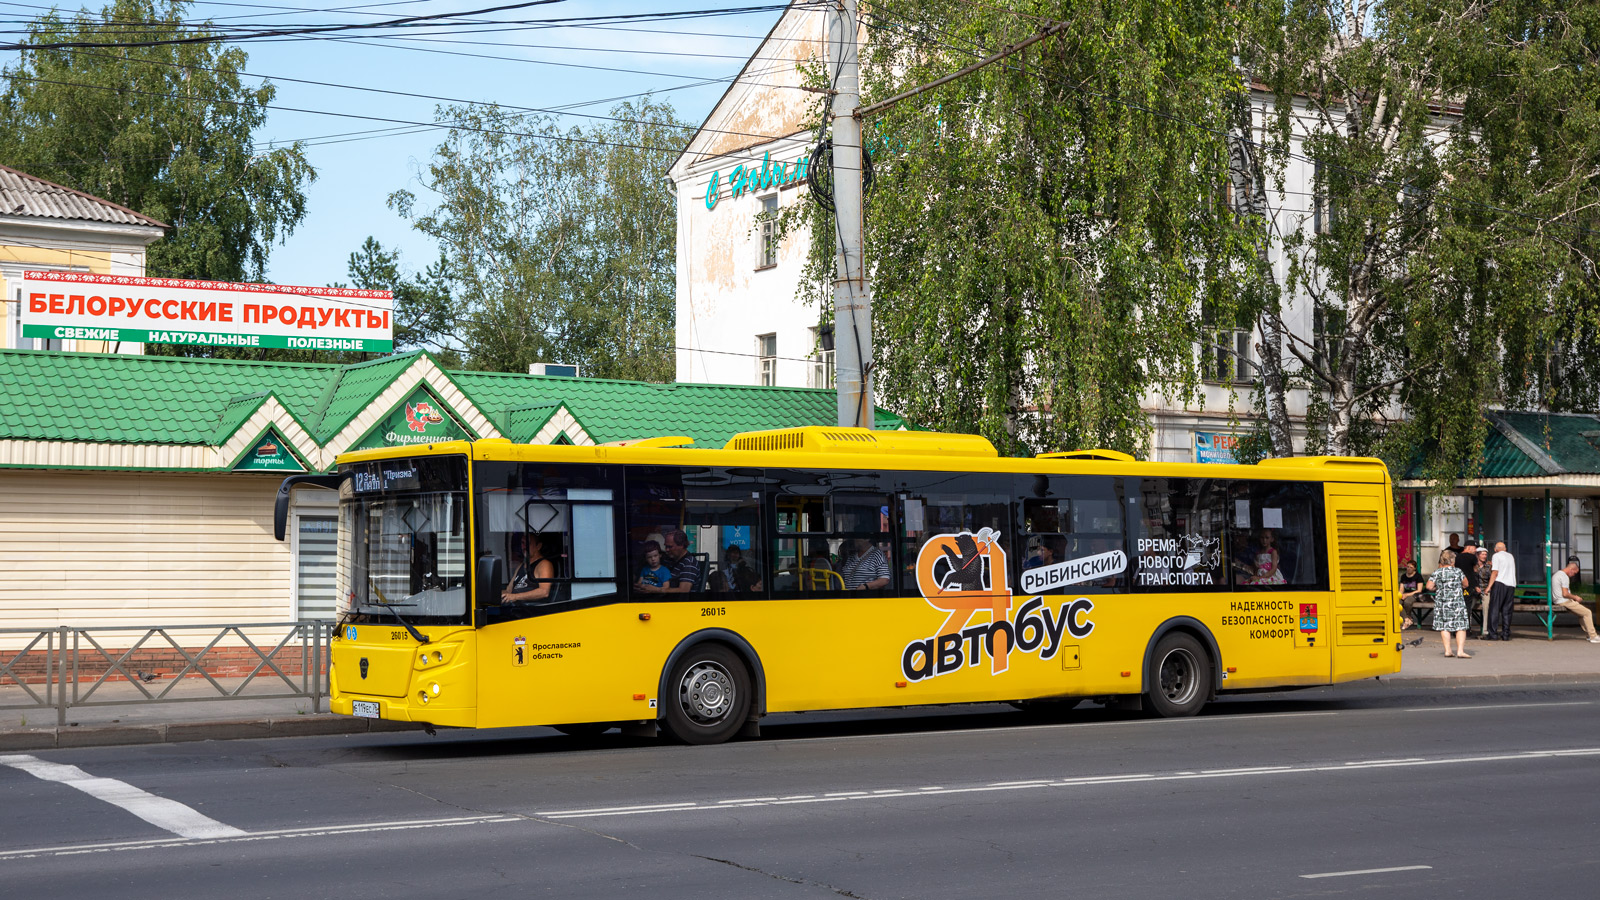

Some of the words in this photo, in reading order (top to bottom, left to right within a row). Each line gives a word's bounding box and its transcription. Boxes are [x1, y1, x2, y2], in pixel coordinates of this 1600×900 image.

[29, 292, 234, 323] БЕЛОРУССКИЕ
[243, 304, 389, 330] ПРОДУКТЫ
[54, 327, 119, 341] СВЕЖИЕ
[148, 331, 260, 347] НАТУРАЛЬНЫЕ
[287, 337, 364, 350] ПОЛЕЗНЫЕ
[253, 458, 285, 468] торты
[355, 472, 364, 492] 12
[1137, 538, 1177, 552] ВРЕМЯ
[1138, 555, 1184, 569] НОВОГО
[1024, 551, 1122, 590] РЫБИНСКИЙ
[1138, 572, 1214, 585] ТРАНСПОРТА
[700, 607, 726, 617] 26015
[1230, 601, 1294, 611] НАДЕЖНОСТЬ
[1221, 615, 1295, 626] БЕЗОПАСНОСТЬ
[390, 631, 408, 640] 26015
[902, 596, 1095, 682] автобус
[1249, 629, 1295, 639] КОМФОРТ
[532, 641, 581, 651] Ярославская
[532, 652, 563, 661] область
